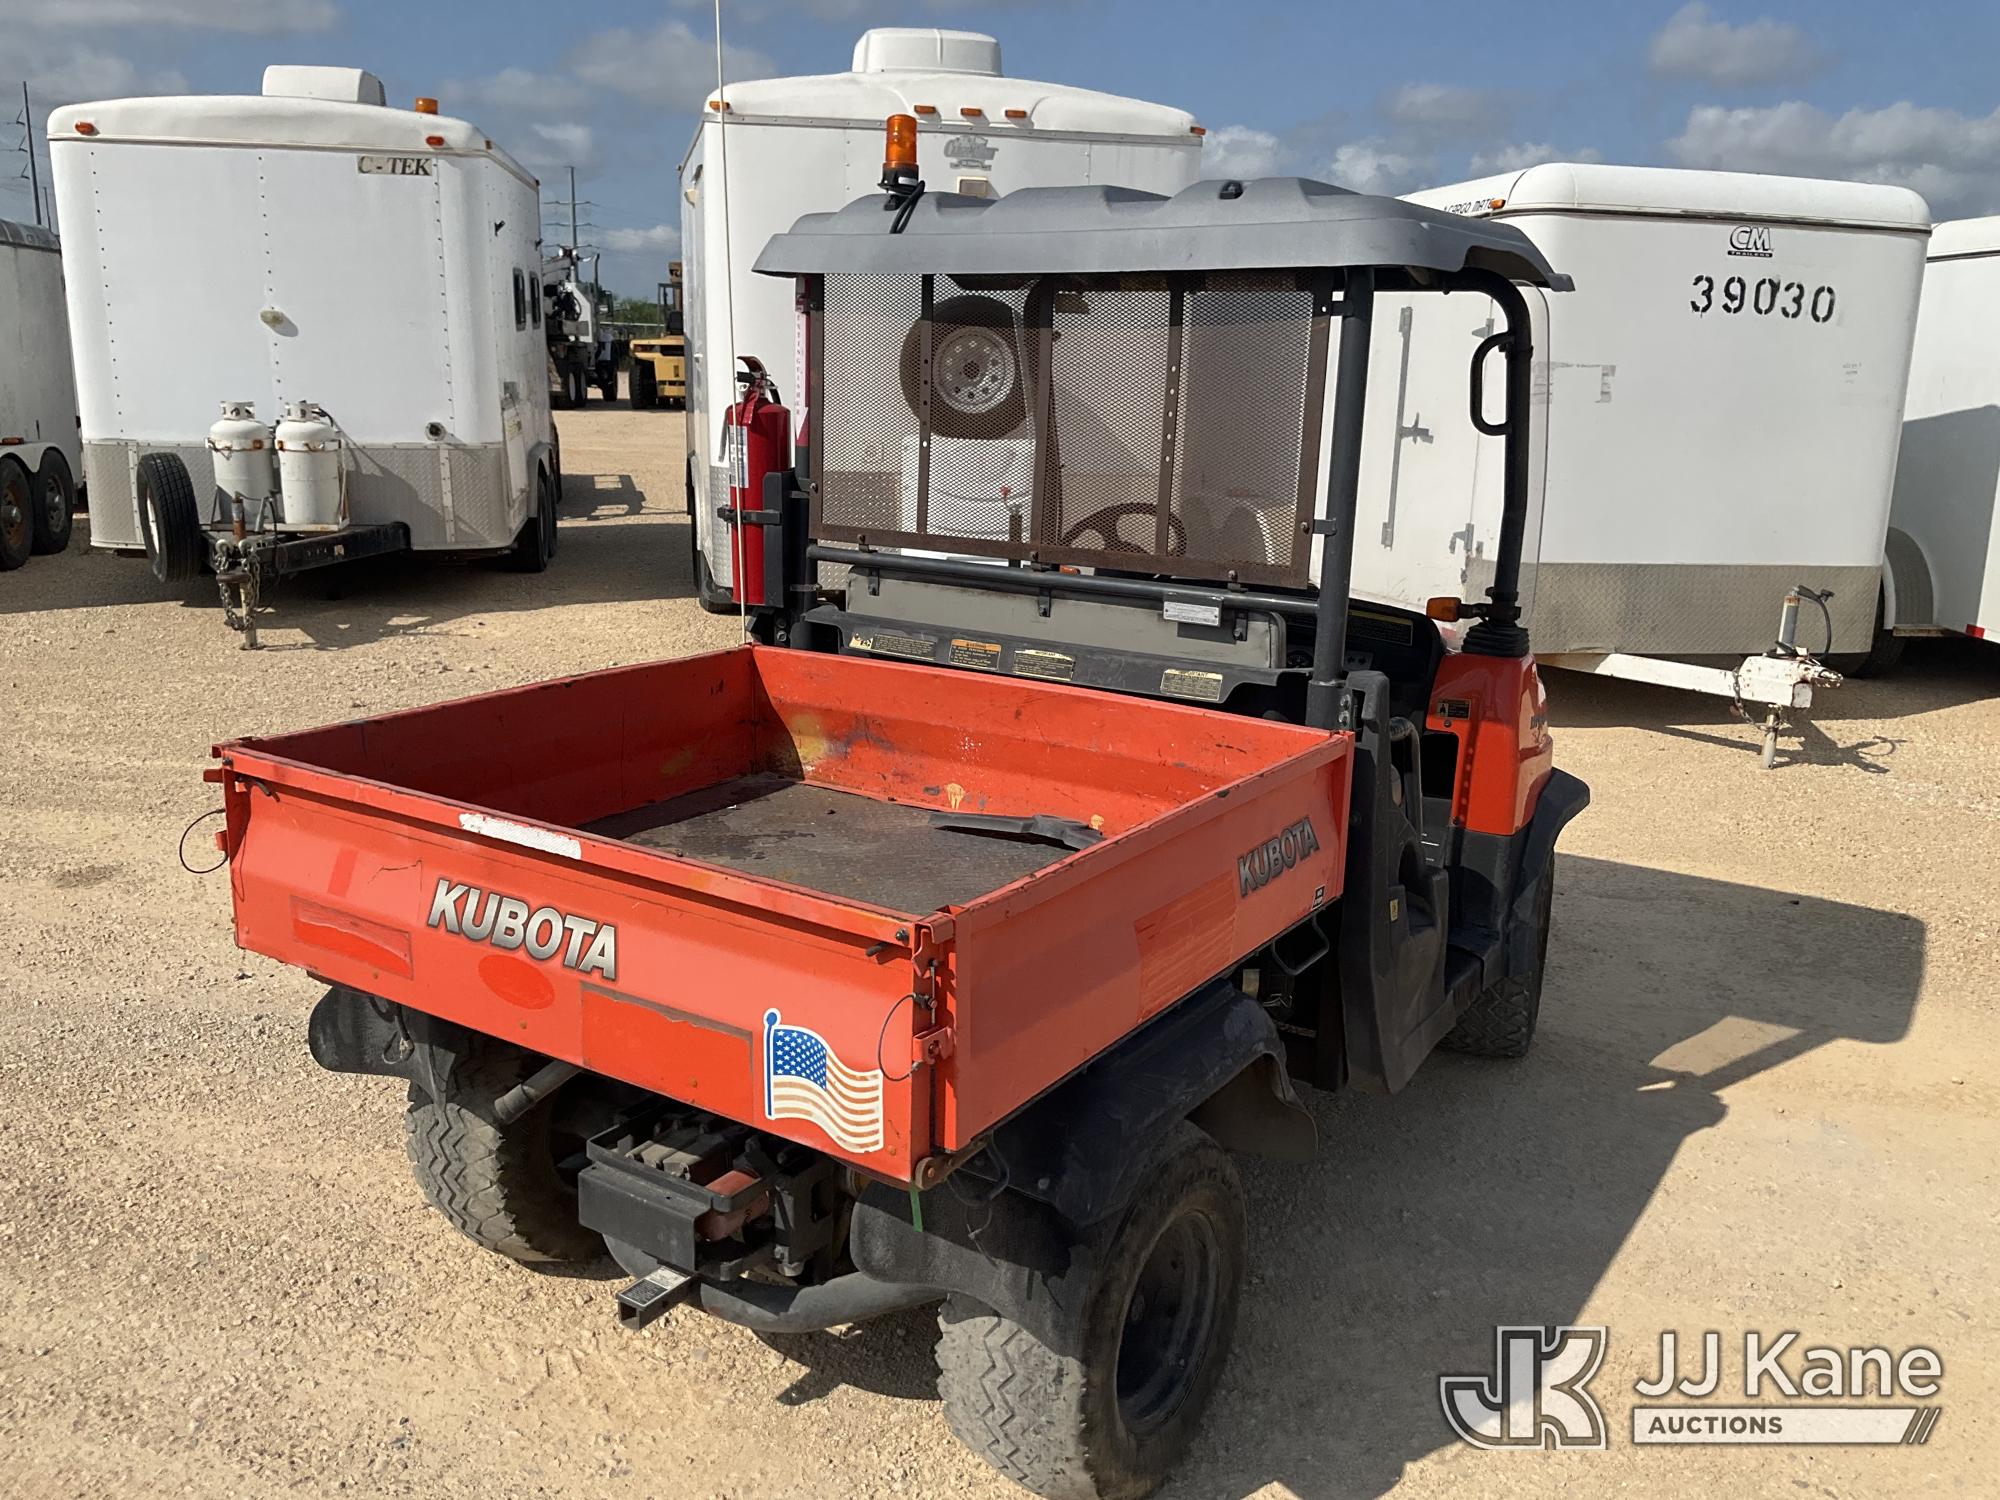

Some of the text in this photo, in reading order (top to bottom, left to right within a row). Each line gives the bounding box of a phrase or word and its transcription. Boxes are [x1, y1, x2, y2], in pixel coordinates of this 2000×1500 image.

[1730, 225, 1770, 251] CM
[1690, 274, 1836, 323] 39030
[1238, 816, 1320, 897] KUBOTA
[427, 878, 617, 981] KUBOTA
